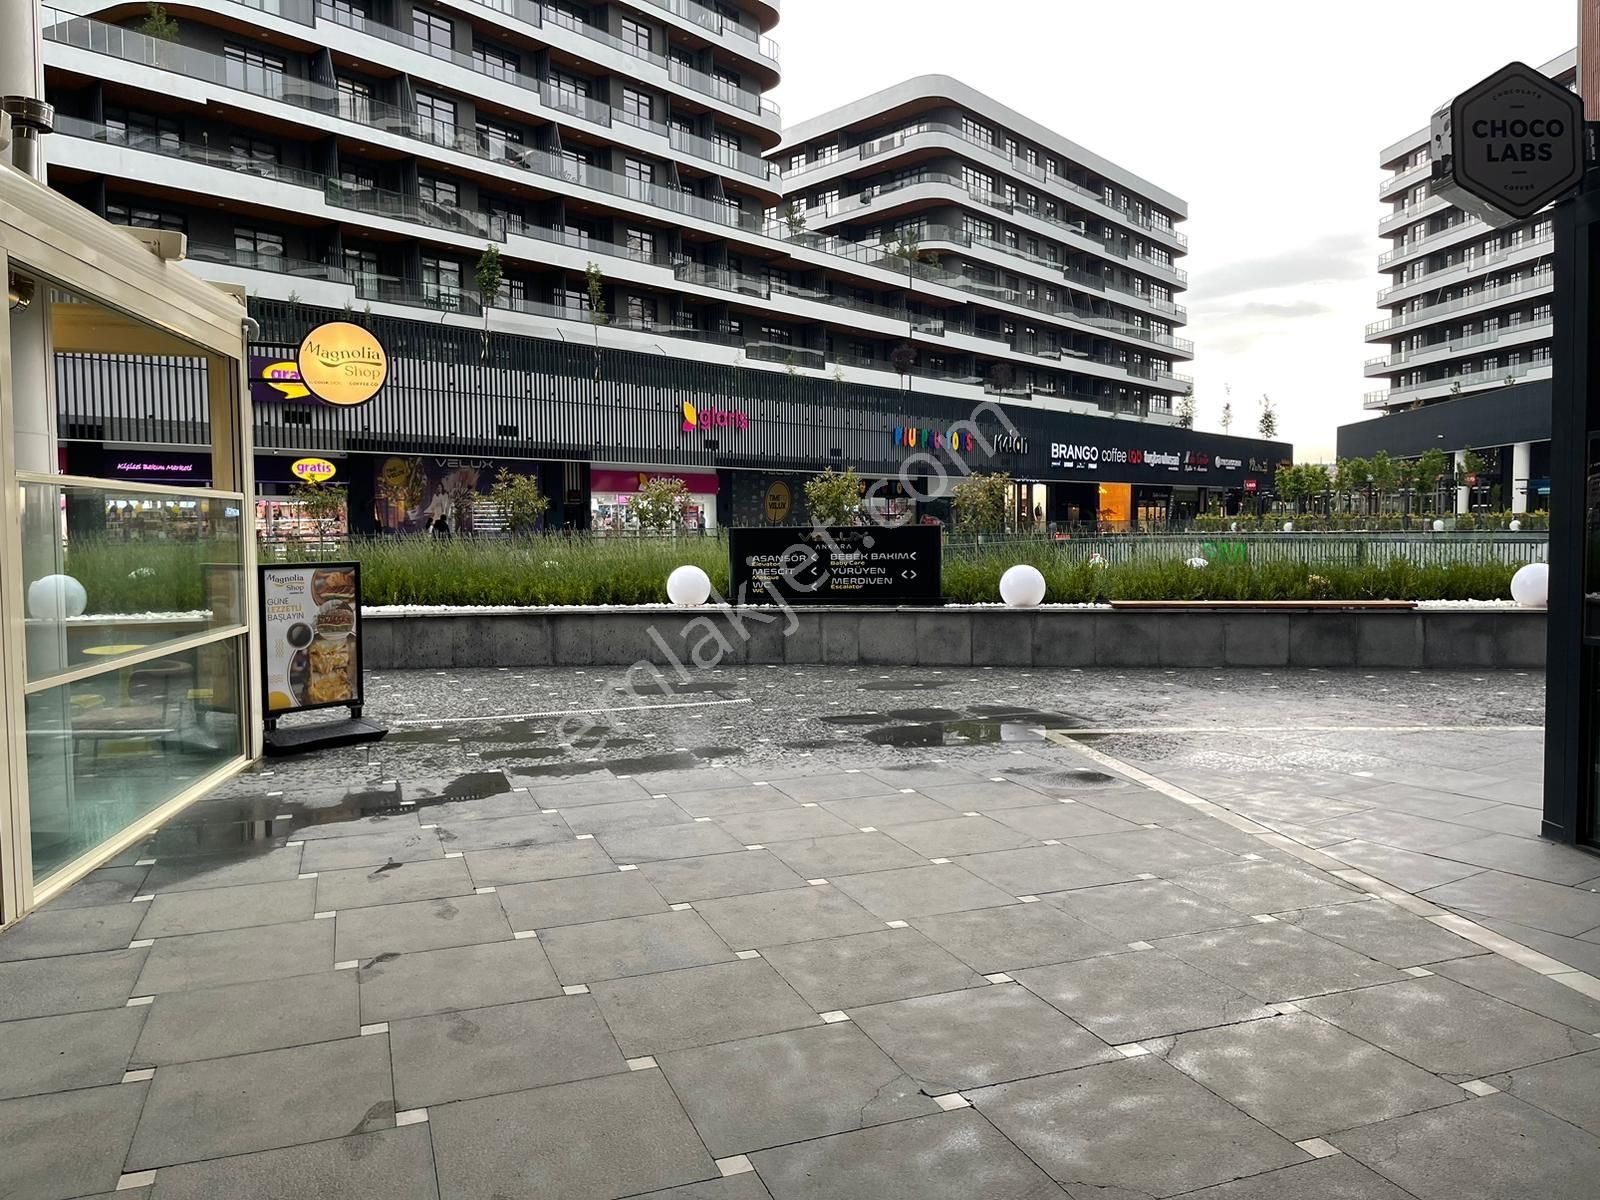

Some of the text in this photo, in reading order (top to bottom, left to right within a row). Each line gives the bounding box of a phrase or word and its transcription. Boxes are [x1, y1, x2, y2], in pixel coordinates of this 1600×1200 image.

[1472, 119, 1564, 139] CHOCO
[1486, 143, 1553, 162] LABS
[304, 340, 380, 361] Magnolia
[344, 366, 381, 379] Shop
[699, 405, 749, 431] glaris
[1051, 442, 1099, 461] BRANGO
[1101, 447, 1127, 463] coffee
[296, 462, 332, 474] gratis
[435, 458, 494, 469] VELUX
[752, 554, 807, 563] ASANSÖR
[830, 552, 910, 561] BEBEK BAKIM
[831, 565, 886, 575] YÜRÜYEN
[266, 574, 304, 584] Magnolia
[286, 584, 304, 592] Shop
[752, 581, 771, 589] WC
[267, 597, 289, 606] GÜNE
[268, 612, 304, 622] BAŞLAYIN
